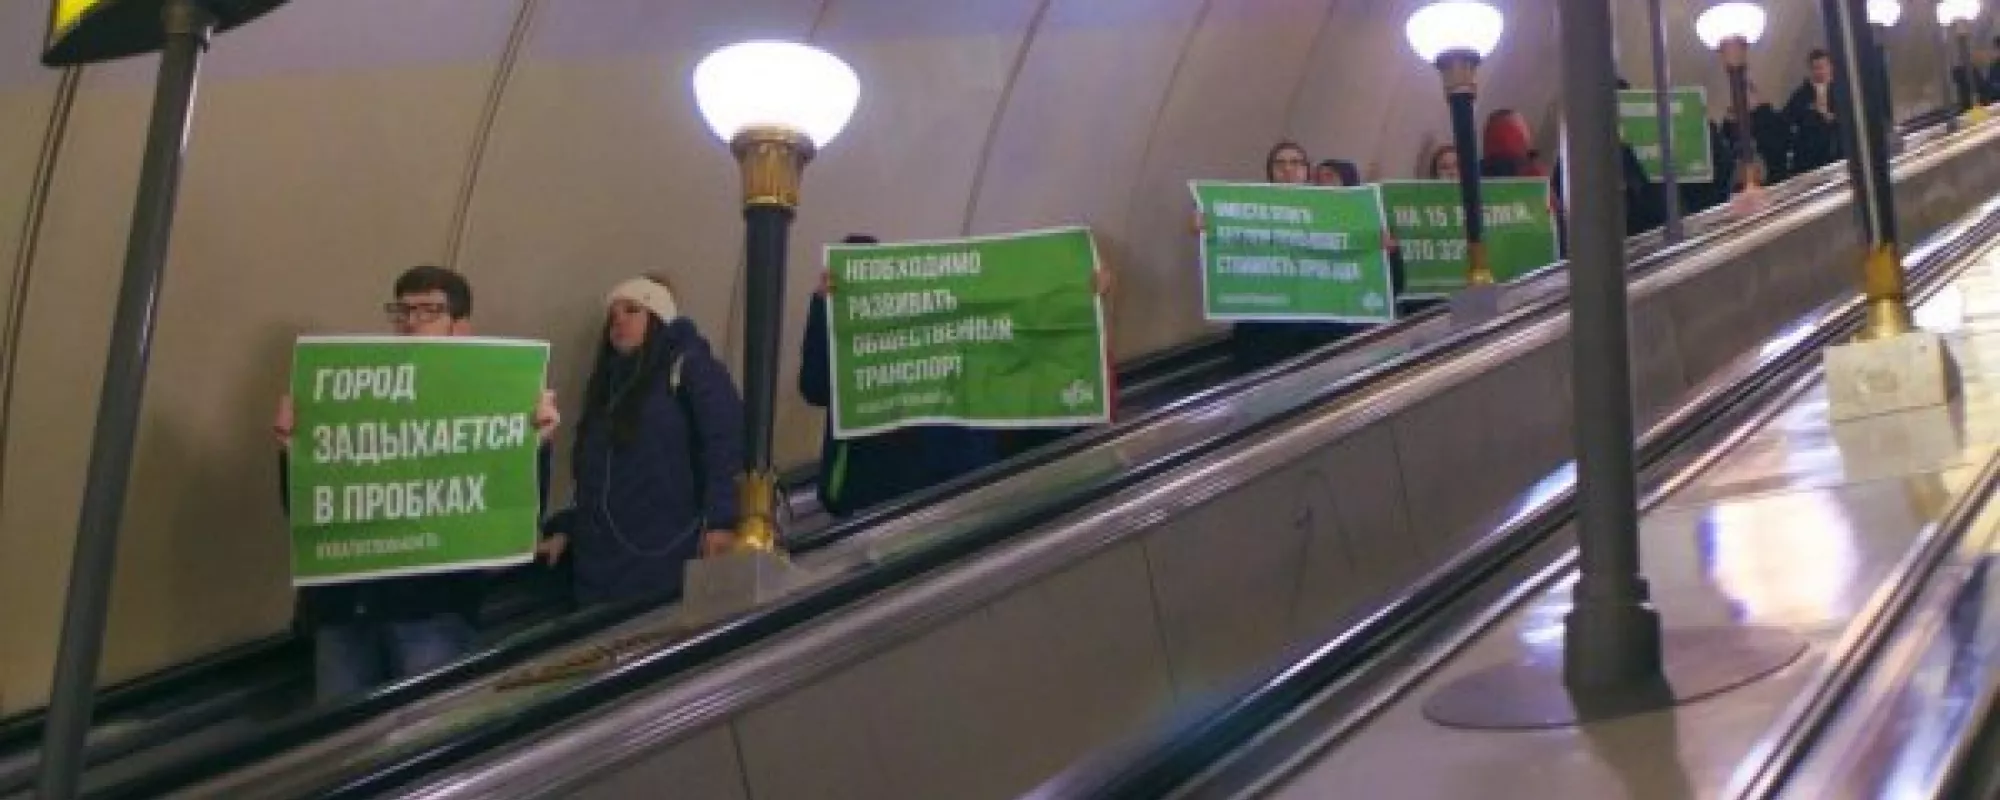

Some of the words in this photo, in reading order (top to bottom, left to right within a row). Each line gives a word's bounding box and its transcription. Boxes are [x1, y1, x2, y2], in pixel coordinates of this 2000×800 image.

[846, 251, 981, 282] НЕОБХОДИМО
[848, 289, 957, 320] РАЗВИВАТЬ
[314, 364, 416, 401] ГОРОД
[855, 355, 962, 390] ТРАНСПОРТ
[314, 413, 526, 465] ЗАДЫХАЕТСЯ
[313, 485, 334, 524] В
[343, 474, 486, 521] ПРОБКАХ
